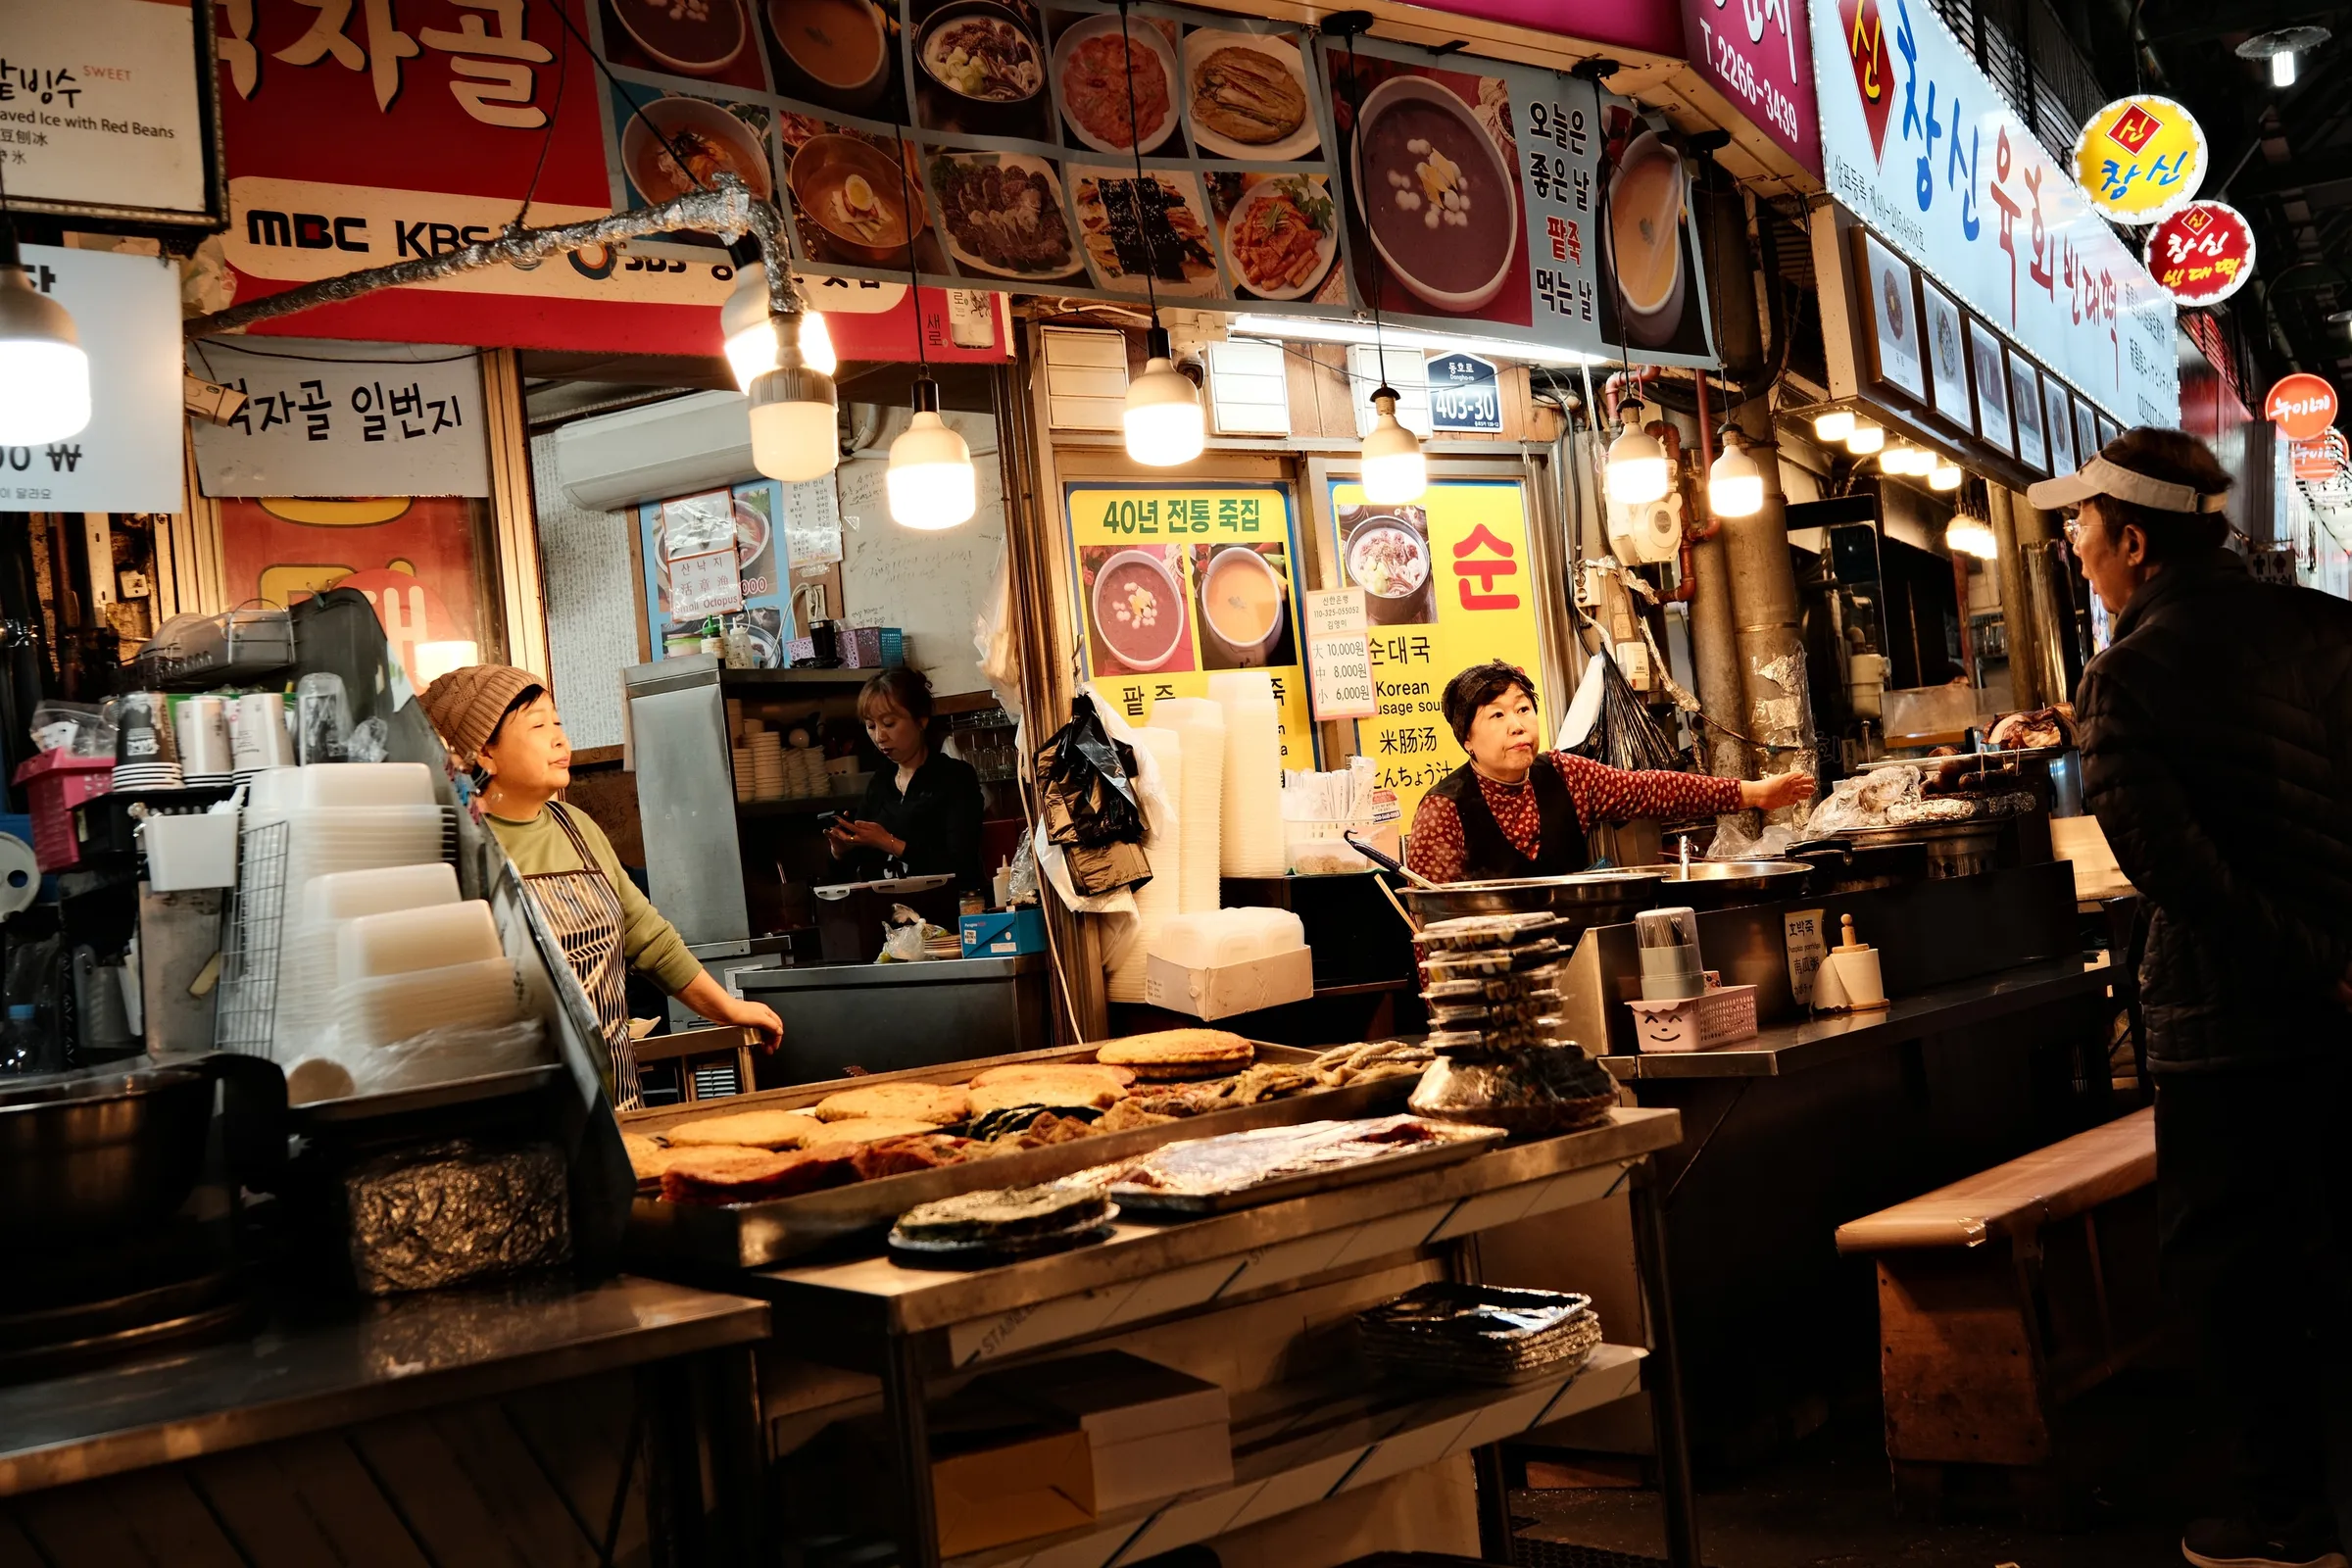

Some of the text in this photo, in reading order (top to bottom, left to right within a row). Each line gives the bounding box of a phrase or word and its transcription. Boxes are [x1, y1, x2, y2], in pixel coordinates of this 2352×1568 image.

[83, 65, 132, 81] SWEET
[1699, 17, 1798, 144] T.2266-3439
[40, 112, 61, 126] Ice
[65, 115, 98, 130] with
[101, 118, 128, 134] Red
[132, 122, 174, 139] Beans
[1529, 102, 1588, 157] 오늘은
[2118, 116, 2150, 143] 신
[1530, 152, 1591, 213] 좋은 날
[2100, 150, 2188, 201] 창신
[246, 209, 369, 253] MBC
[1545, 215, 1583, 268] 팥죽
[2167, 230, 2230, 265] 창신
[2162, 257, 2241, 288] 빈대떡
[1536, 268, 1592, 322] 먹는 날
[1448, 362, 1475, 374] 동호로
[351, 380, 463, 442] 일번지
[1436, 391, 1495, 421] 403-30
[1103, 499, 1260, 534] 40년 전통 죽집
[1452, 522, 1521, 611] 순
[703, 595, 738, 610] Octopus
[1313, 606, 1360, 618] 110-325-055052
[1322, 595, 1348, 607] 신한은행
[1313, 640, 1365, 660] 大 10,000원
[1369, 636, 1431, 666] 순대국
[1315, 662, 1368, 682] 中 8,000원
[1317, 684, 1370, 704] 小 6,000원
[1375, 680, 1430, 698] Korean
[1379, 726, 1438, 756] 米肠汤
[1788, 919, 1814, 937] 호박죽
